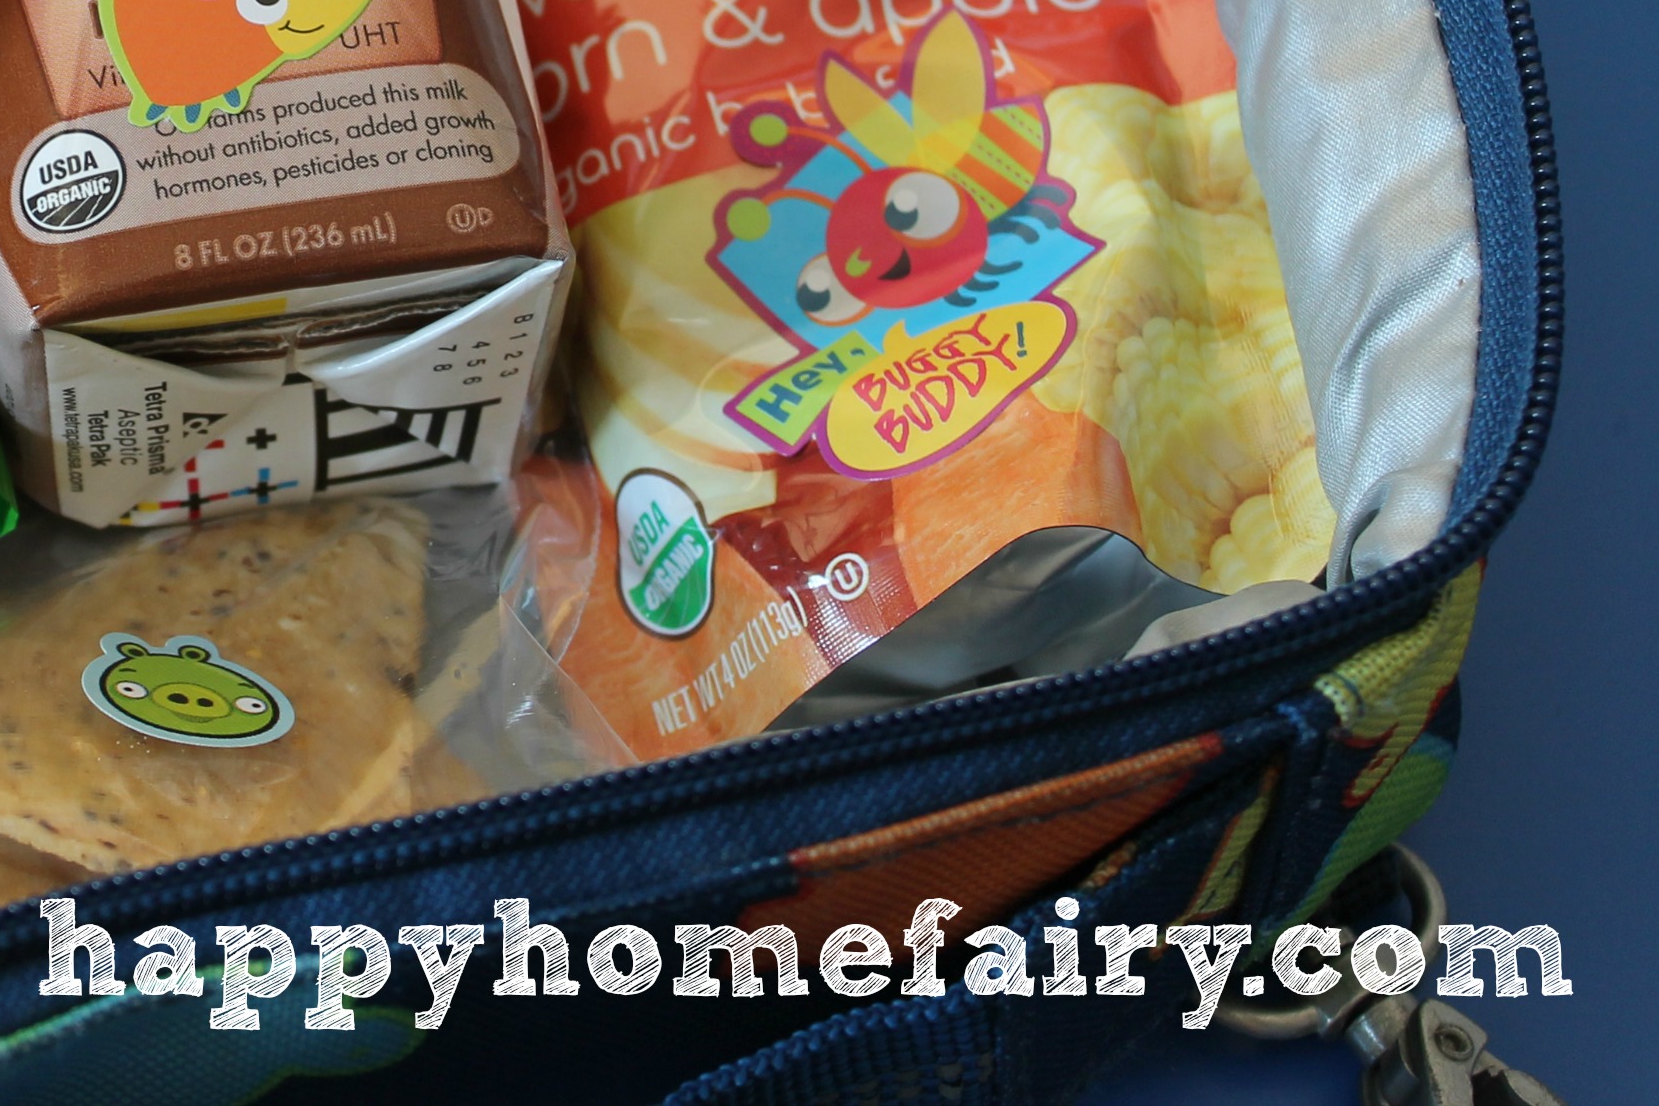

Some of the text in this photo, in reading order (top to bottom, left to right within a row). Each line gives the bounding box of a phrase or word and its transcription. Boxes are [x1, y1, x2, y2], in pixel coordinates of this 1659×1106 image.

[534, 20, 668, 123] orn
[273, 84, 377, 126] produced
[382, 81, 419, 104] this
[426, 79, 468, 100] milk
[39, 150, 99, 185] USDA
[136, 110, 495, 172] without antibiotics, added growth
[154, 139, 494, 200] hormones, pesticides or cloning
[36, 177, 111, 213] ORGANIC
[174, 212, 397, 271] 8 FL OZ (236 mL)
[433, 344, 457, 372] 7 8
[467, 359, 486, 368] 5
[471, 341, 490, 349] 4
[499, 368, 519, 378] 3
[504, 351, 523, 361] 2
[852, 313, 992, 411] BUGGY
[144, 381, 167, 422] Tetra
[755, 348, 866, 424] Hey,
[874, 321, 1027, 453] BUDDY!
[62, 387, 84, 492] www.tetrapakusa.com
[88, 410, 112, 467] Tetra Pak
[114, 408, 142, 466] Aseptic
[627, 500, 669, 567] USDA
[651, 685, 697, 736] NET
[693, 661, 724, 712] WT
[721, 654, 735, 688] 4
